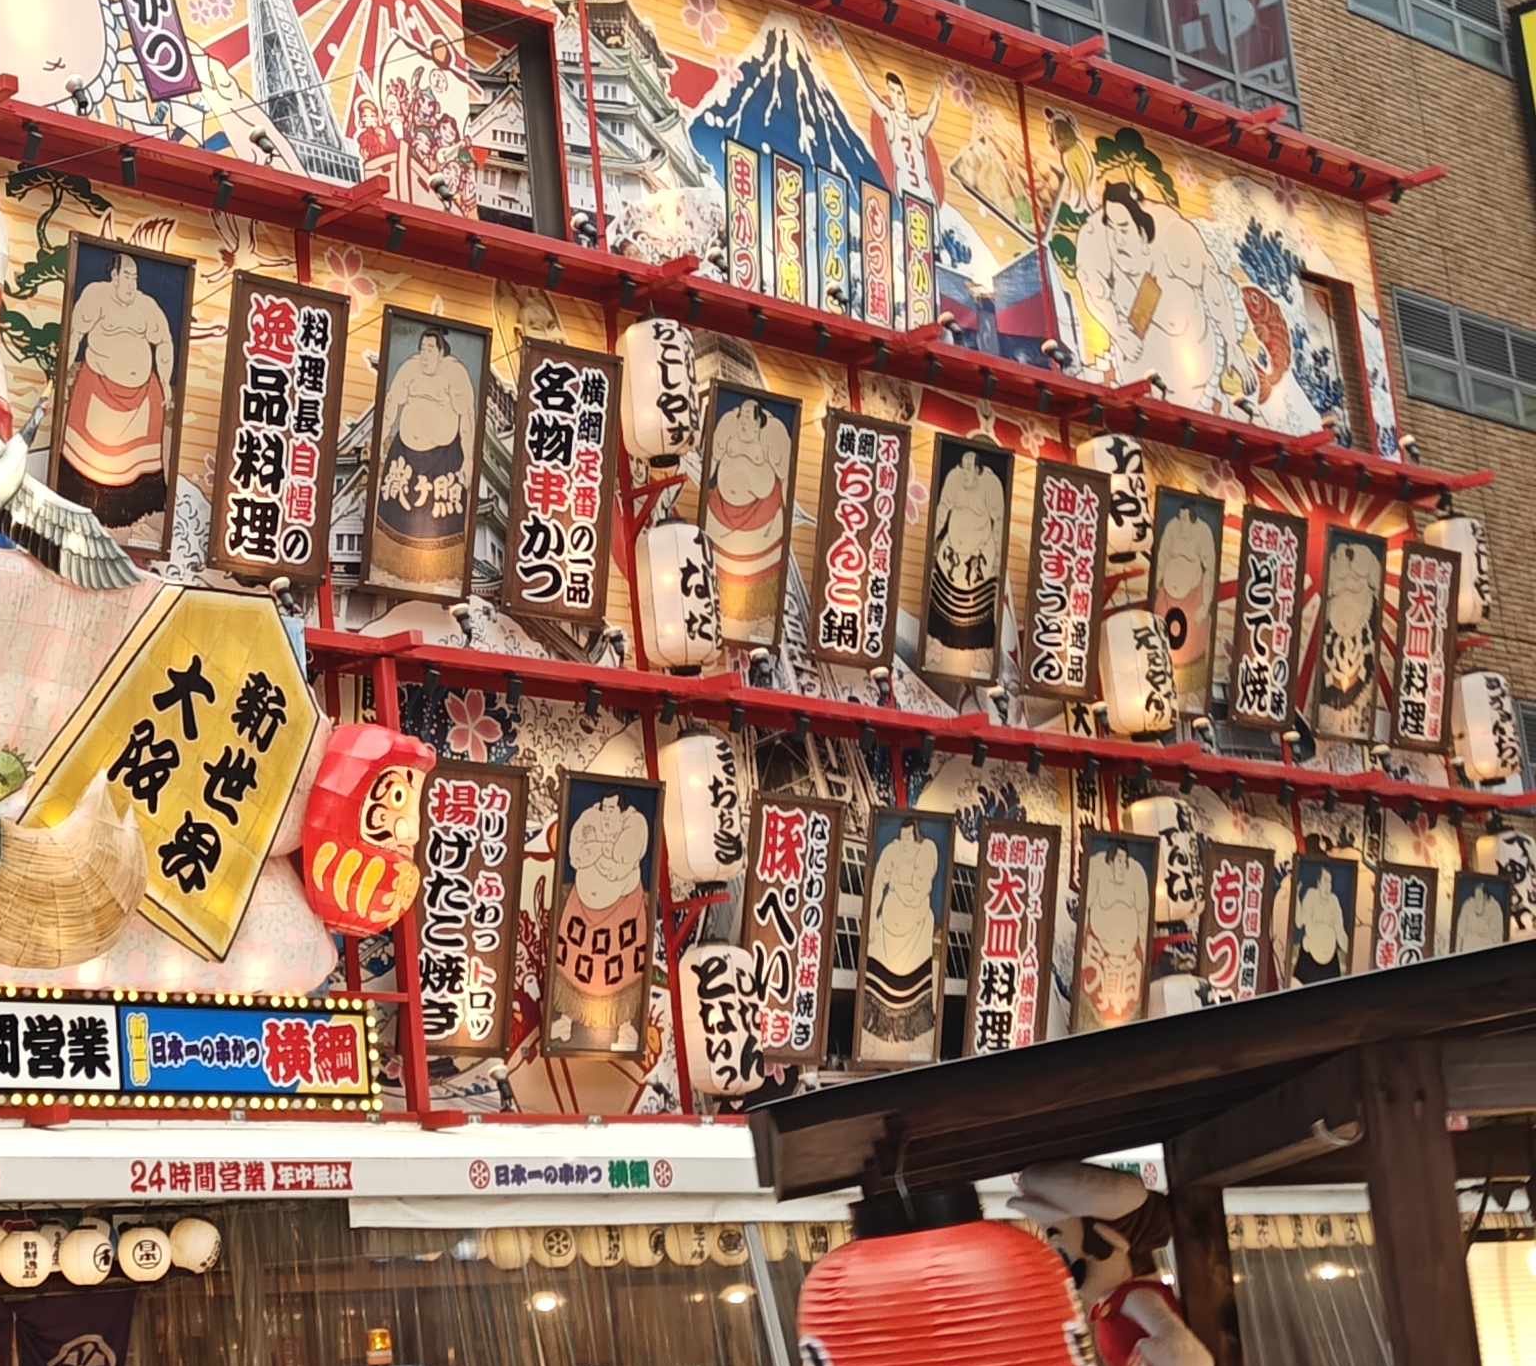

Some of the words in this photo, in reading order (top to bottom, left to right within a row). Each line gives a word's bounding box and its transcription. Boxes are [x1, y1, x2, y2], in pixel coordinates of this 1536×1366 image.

[731, 153, 754, 290] 串かつ
[231, 297, 297, 560] 逸品料理
[285, 309, 329, 560] 料理長自慢の
[652, 321, 689, 447] おこしやす
[518, 361, 577, 601] 名物串かつ
[566, 368, 607, 606] 横綱定番の一品
[821, 463, 872, 649] ちゃんこ鍋
[864, 438, 899, 657] 不動の人気を誇る
[1032, 478, 1077, 681] 油かすうどん
[107, 654, 216, 815] 大阪
[158, 671, 288, 895] 新世界
[421, 780, 478, 1036] 揚げたこ焼き
[473, 872, 504, 951] ふわっ
[479, 787, 509, 865] カリッ
[467, 960, 497, 1039] トロッ
[794, 813, 829, 1048] なにわの鉄板焼き
[977, 871, 1024, 1053] 大皿料理
[1208, 859, 1241, 1002] もつ
[152, 1034, 260, 1068] 日本一の串かつ
[264, 1021, 359, 1086] 横綱
[131, 1161, 266, 1192] 24時間営業
[277, 1165, 348, 1189] 年中無休
[494, 1165, 602, 1186] 日本一の串かつ
[609, 1160, 650, 1188] 横綱
